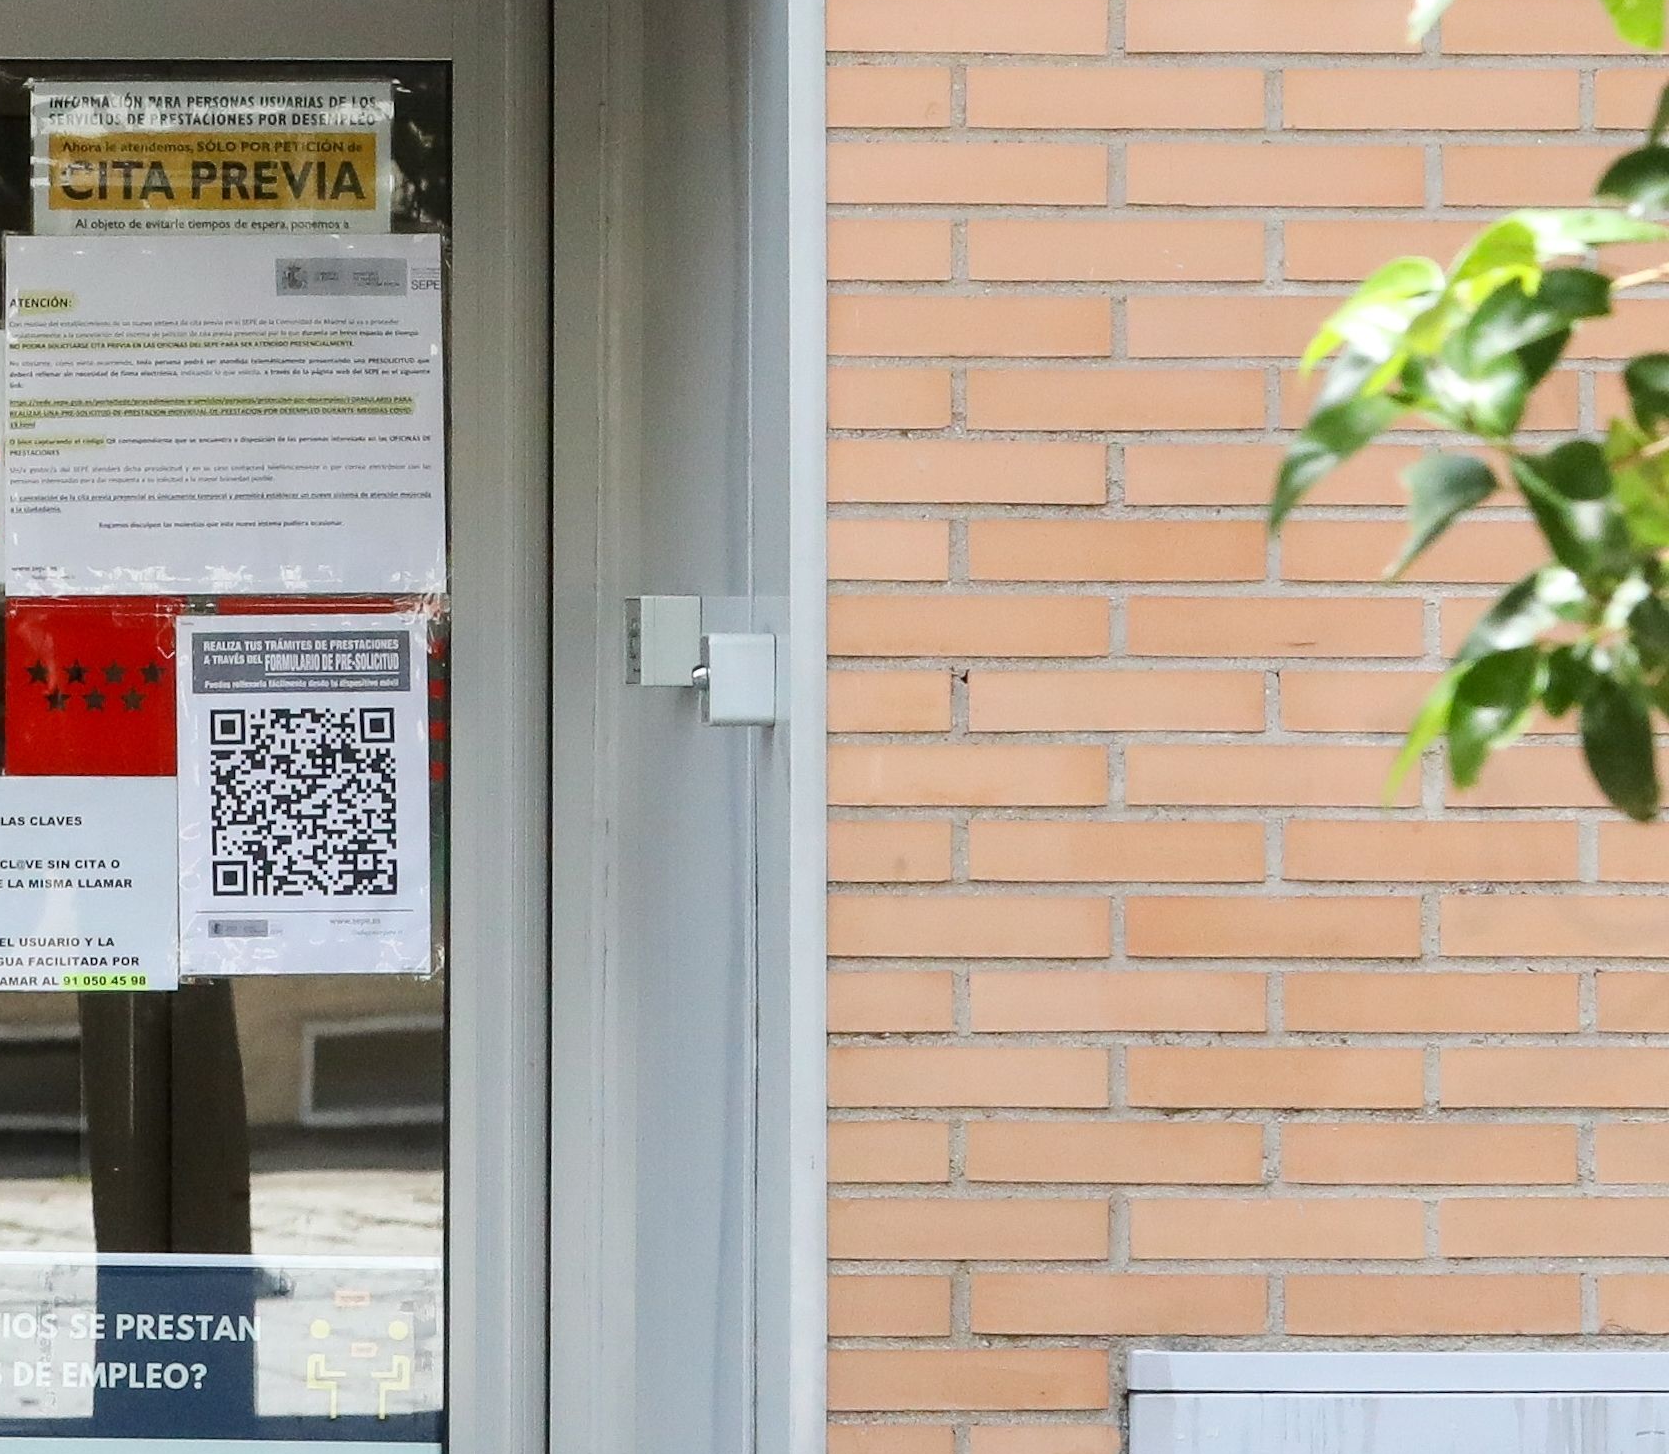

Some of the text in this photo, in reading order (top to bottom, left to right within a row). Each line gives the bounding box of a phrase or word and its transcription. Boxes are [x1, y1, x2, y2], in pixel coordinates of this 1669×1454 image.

[149, 97, 181, 109] PARA
[187, 97, 255, 109] PERSONAS
[260, 97, 323, 109] USUARIAS
[329, 97, 346, 109] DE
[351, 97, 376, 109] LOS
[49, 113, 376, 126] SERVICIOS DE PRESTACIONES POR DESEMPLEO
[62, 160, 366, 201] CITA PREVIA
[411, 279, 440, 290] SEPE
[10, 296, 72, 308] ATENCIÓN:
[0, 816, 25, 826] LAS
[30, 816, 82, 826] CLAVES
[47, 859, 70, 870] SIN
[75, 859, 106, 870] CITA
[110, 859, 120, 870] O
[7, 878, 24, 889] LA
[28, 878, 73, 889] MISMA
[78, 878, 133, 889] LLAMAR
[19, 937, 80, 948] USUARIO
[84, 937, 93, 948] Y
[98, 937, 114, 948] LA
[28, 956, 108, 967] FACILITADA
[112, 956, 140, 967] POR
[42, 976, 58, 987] AL
[63, 976, 79, 987] 91
[83, 976, 107, 987] 050
[110, 976, 127, 987] 45
[131, 976, 147, 987] 98
[69, 1310, 106, 1341] SE
[116, 1313, 260, 1342] PRESTAN
[13, 1360, 52, 1388] DE
[61, 1360, 208, 1390] EMPLEO?
